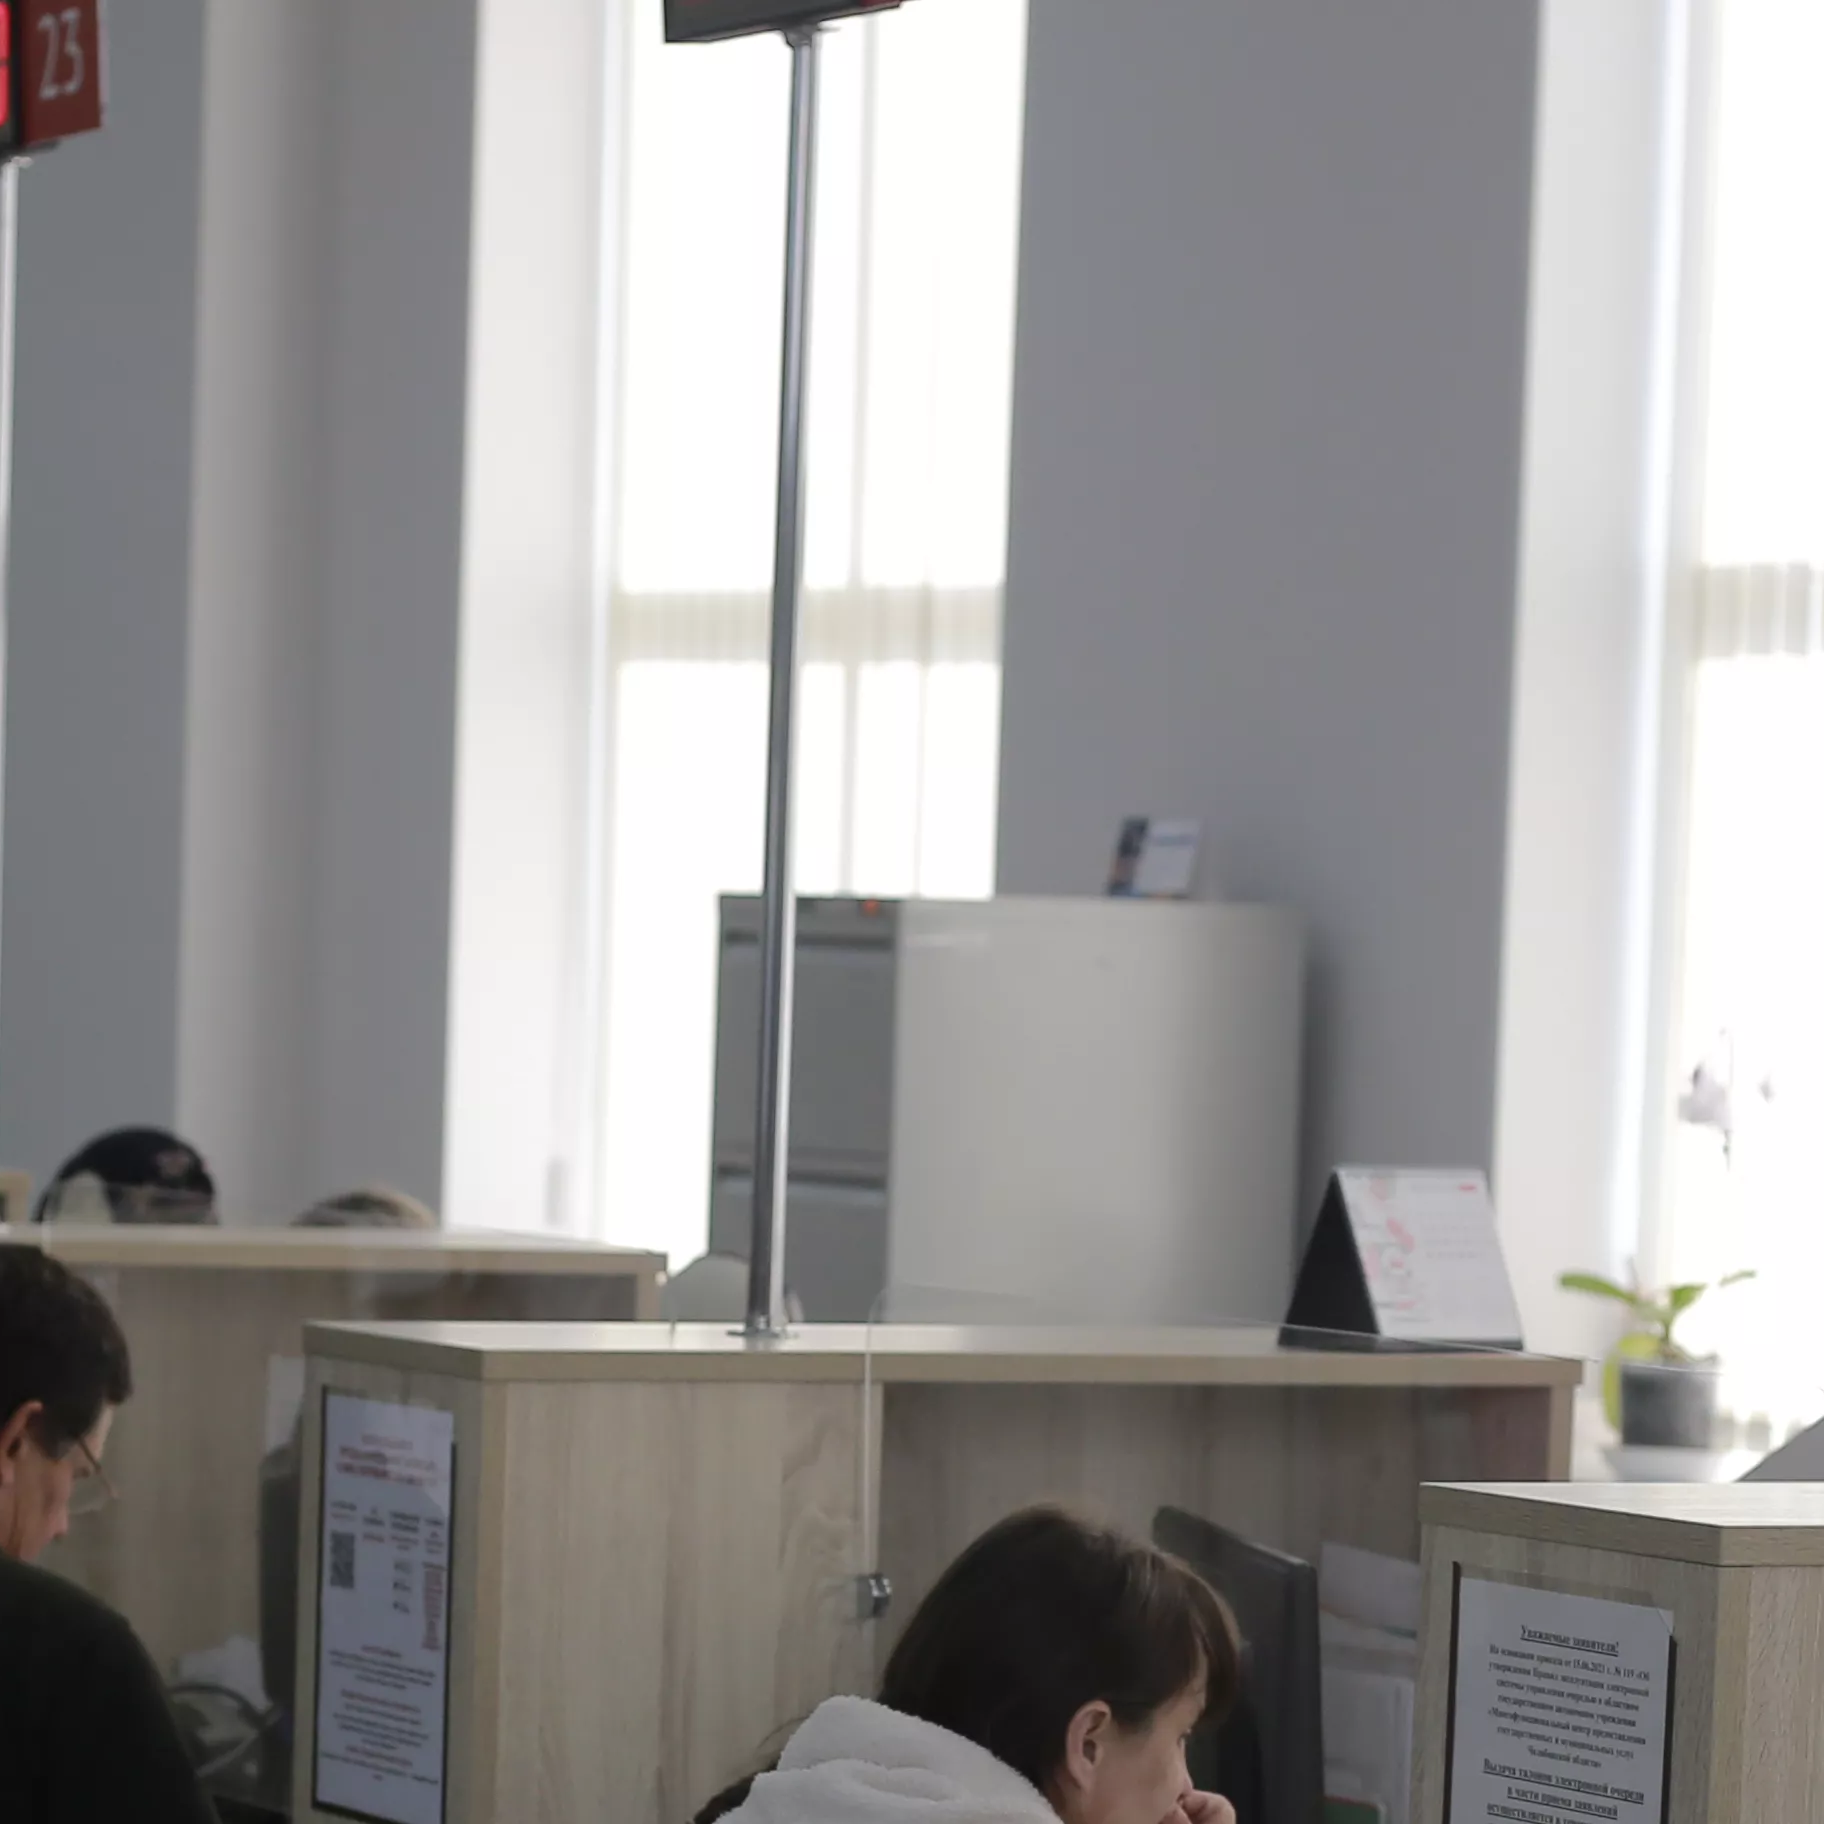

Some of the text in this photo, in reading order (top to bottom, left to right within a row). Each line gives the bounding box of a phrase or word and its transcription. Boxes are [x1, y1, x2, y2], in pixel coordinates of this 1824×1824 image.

[36, 7, 85, 101] 23
[1521, 1624, 1618, 1654] Уважаемые заявители!
[1484, 1758, 1516, 1776] Выдача
